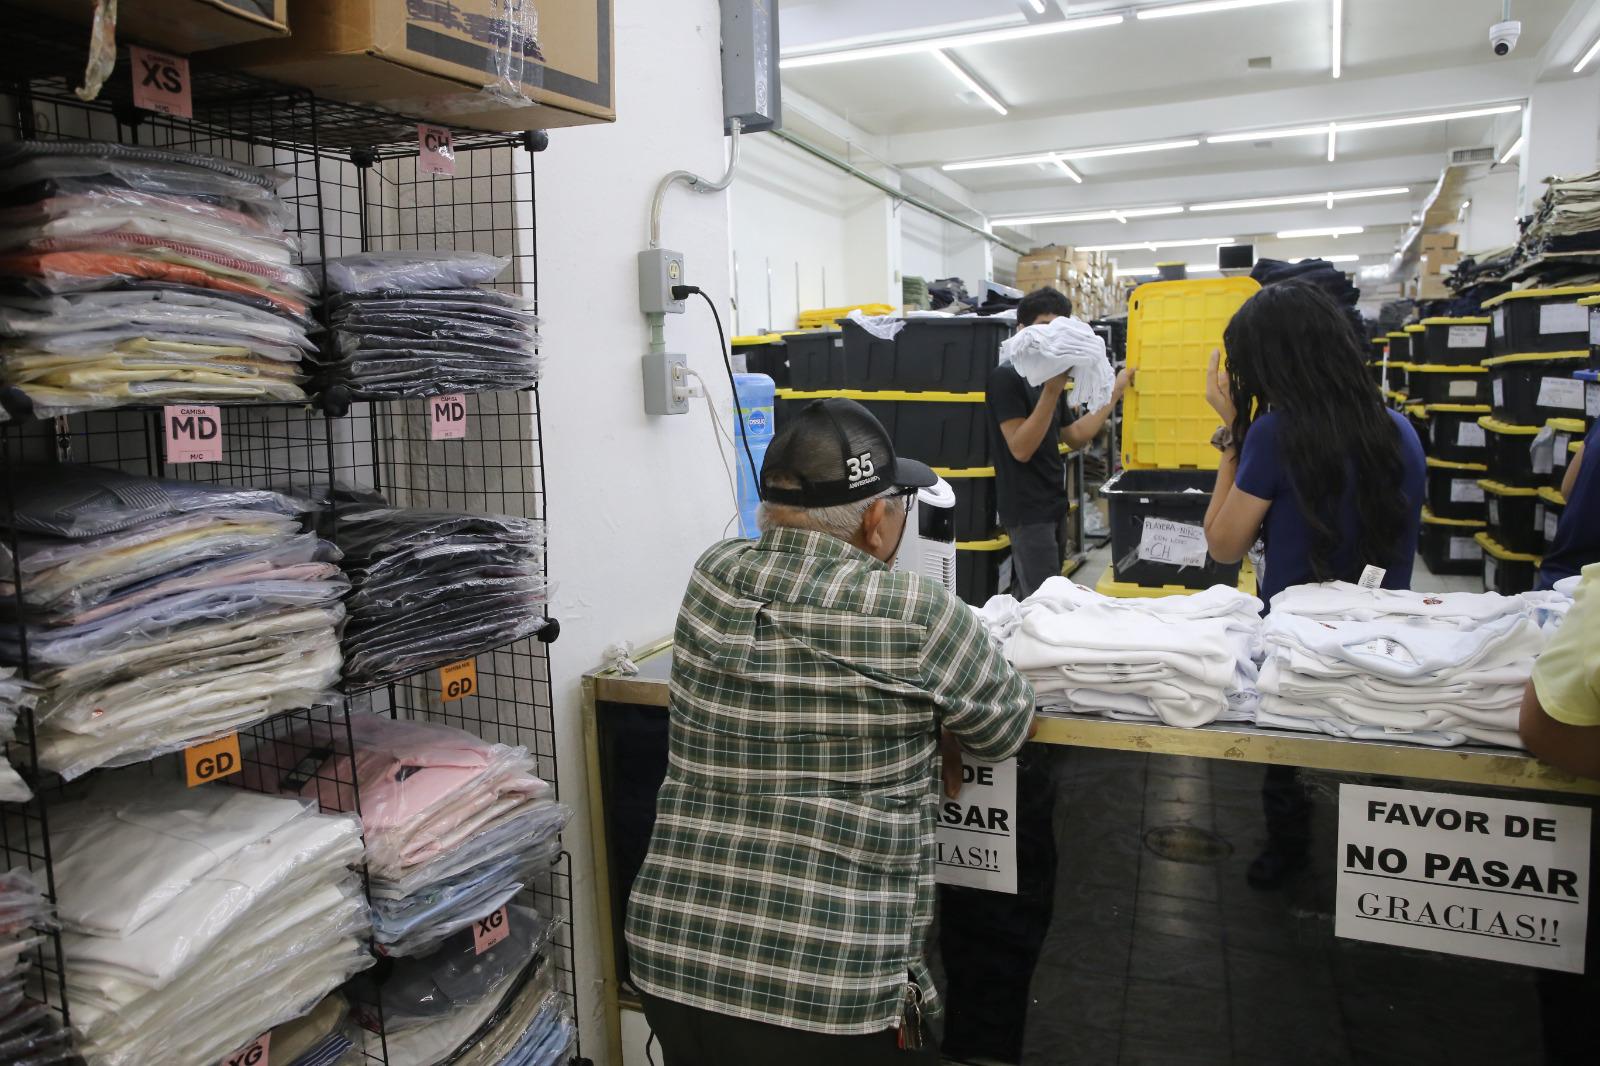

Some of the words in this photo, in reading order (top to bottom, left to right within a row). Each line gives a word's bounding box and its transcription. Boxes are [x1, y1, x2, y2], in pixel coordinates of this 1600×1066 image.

[141, 60, 182, 94] XS
[435, 402, 465, 422] MD
[171, 416, 218, 440] MD
[846, 452, 875, 482] 35
[447, 677, 473, 698] GD
[195, 751, 234, 779] GD
[961, 764, 994, 787] DE
[938, 801, 1010, 832] SAR
[1367, 800, 1490, 835] FAVOR
[1504, 814, 1557, 842] DE
[936, 842, 1000, 869] IAS!!
[1346, 843, 1408, 874] NO
[1424, 852, 1579, 898] PASAR
[478, 909, 503, 938] XG
[1357, 892, 1560, 943] GRACIAS!!
